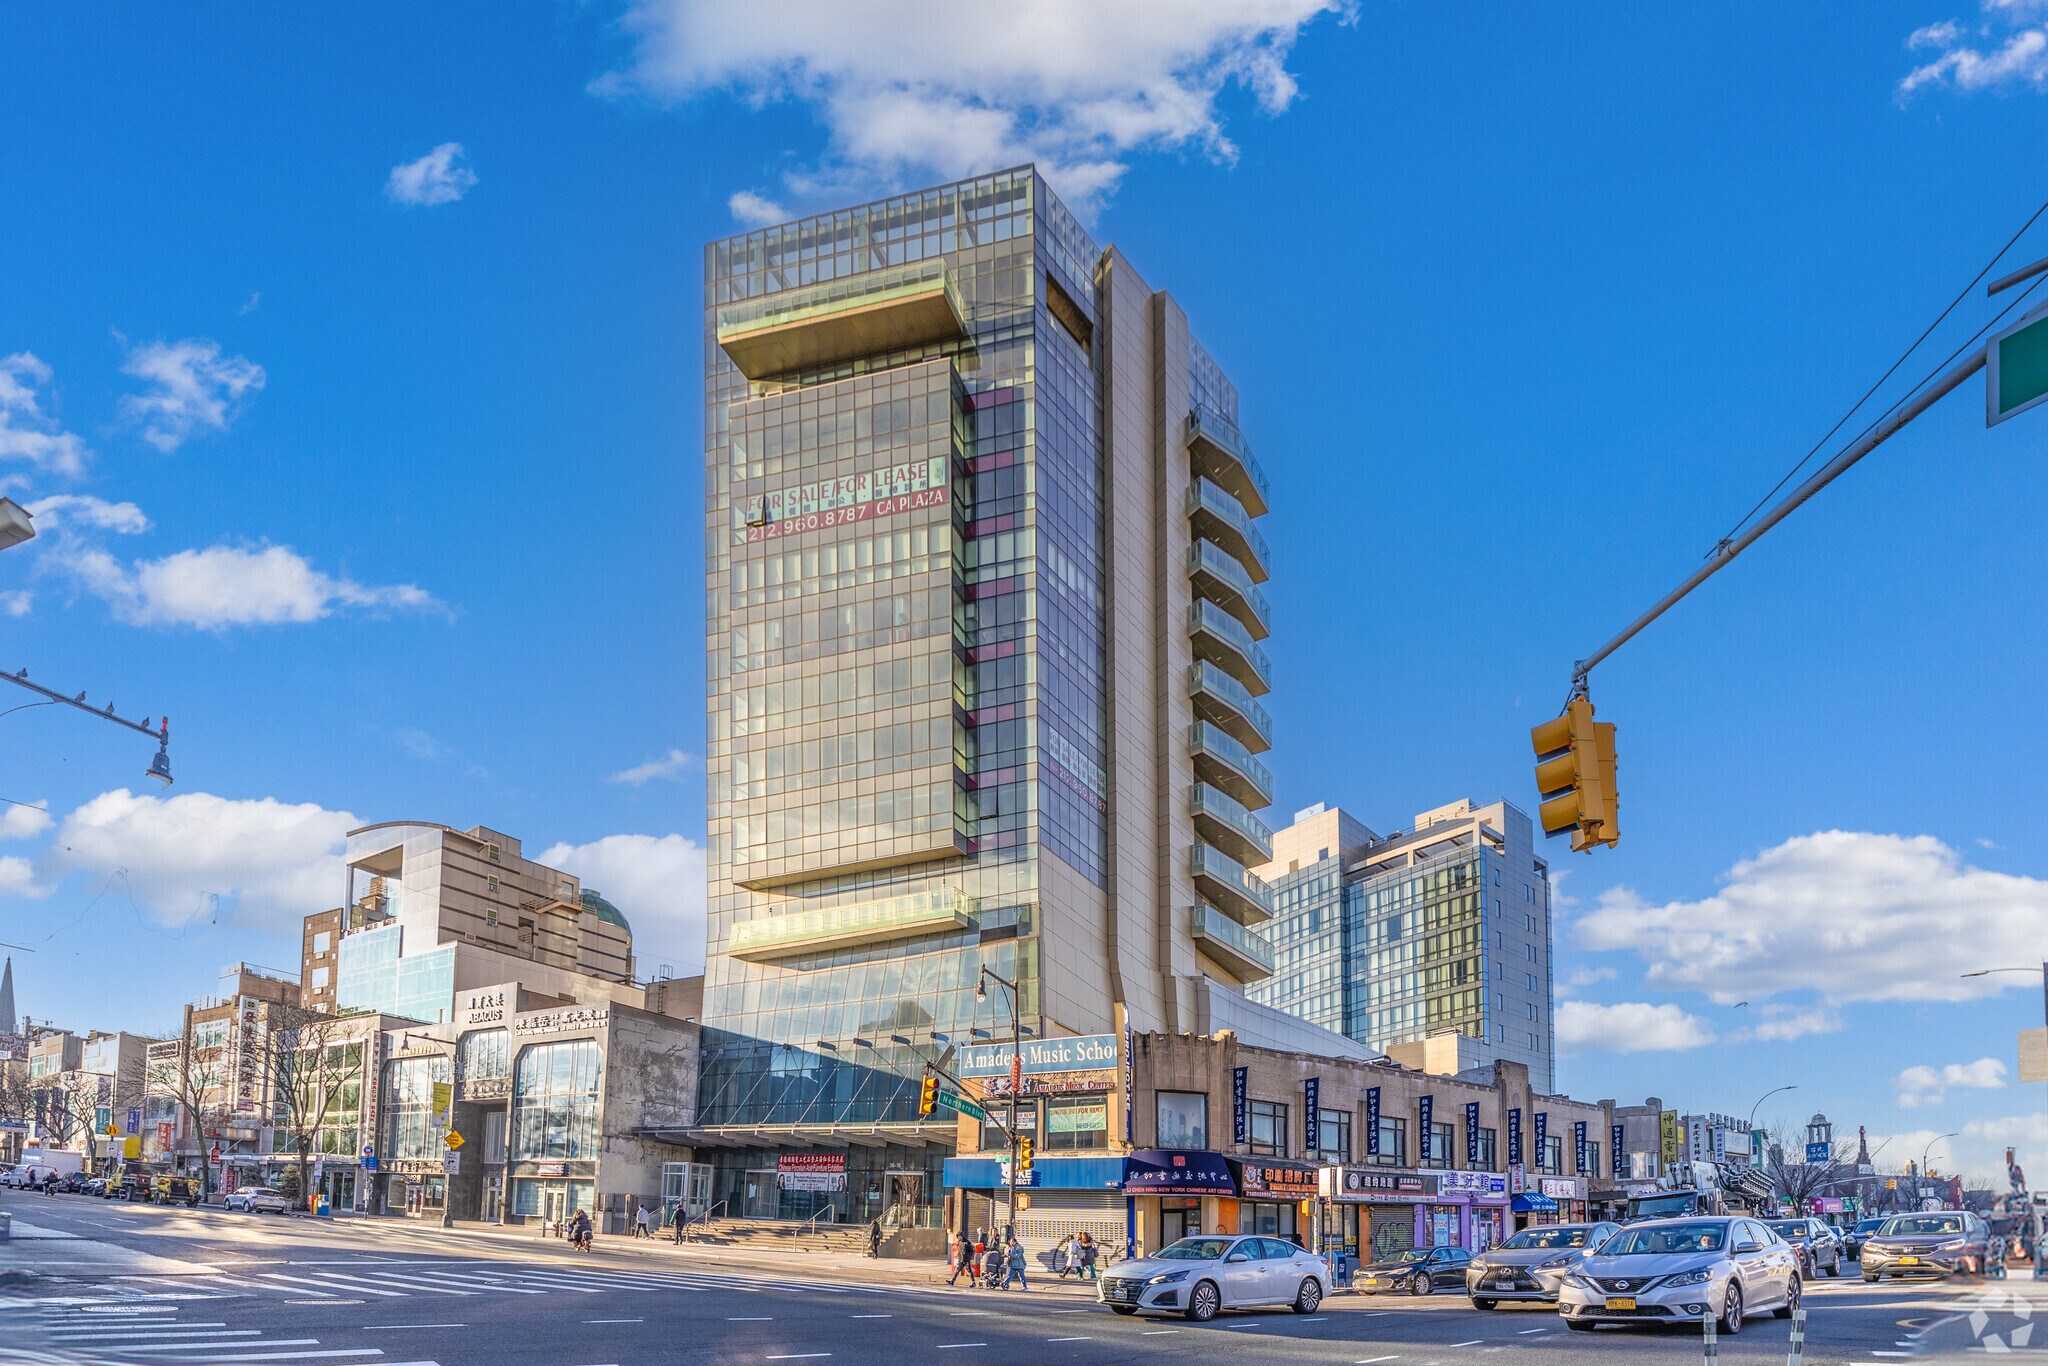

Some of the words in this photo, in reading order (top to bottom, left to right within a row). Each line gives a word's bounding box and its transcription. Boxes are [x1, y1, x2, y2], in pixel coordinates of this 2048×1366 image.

[748, 494, 781, 511] FOR
[788, 475, 866, 506] SALE/FOR
[875, 464, 926, 487] LEASE
[749, 505, 866, 540] 212.960.8787
[876, 499, 895, 515] CA
[900, 490, 943, 510] PLAZA
[469, 1009, 503, 1024] ABACUS
[964, 1048, 1026, 1069] Amades
[1030, 1044, 1071, 1064] Music
[1065, 1082, 1085, 1091] MUSIC
[1088, 1081, 1113, 1090] CENTER
[943, 1095, 971, 1112] Northern
[971, 1107, 983, 1117] Blvd
[1449, 1172, 1489, 1189] 美牙館
